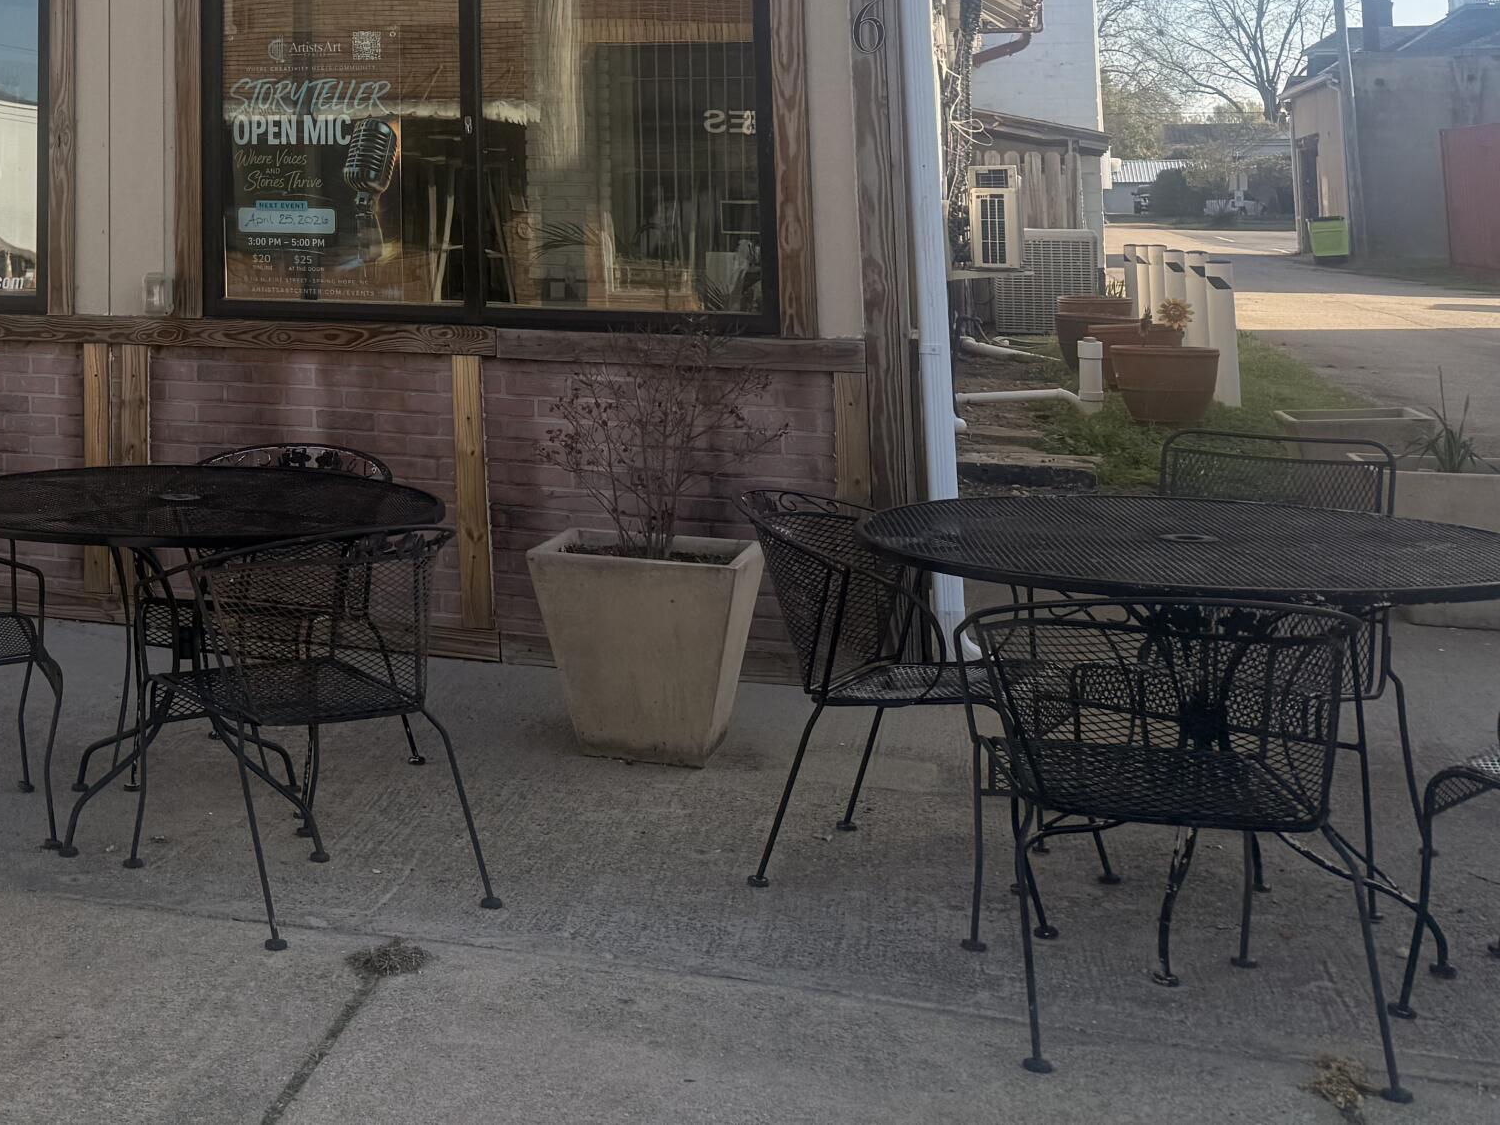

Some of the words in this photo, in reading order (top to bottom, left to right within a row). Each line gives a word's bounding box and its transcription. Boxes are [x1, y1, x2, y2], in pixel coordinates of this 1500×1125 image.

[288, 41, 324, 53] Artists
[324, 40, 342, 53] Art
[230, 77, 394, 115] STORYTELLER
[233, 114, 297, 145] OPEN
[303, 114, 351, 145] MIC
[235, 148, 273, 168] Where
[274, 148, 307, 167] Voices
[244, 169, 285, 191] Stories
[284, 170, 323, 191] Thrive
[258, 202, 279, 210] NEXT
[280, 202, 305, 210] EVENT
[248, 237, 267, 246] 3:00
[268, 237, 282, 246] PM
[291, 238, 310, 247] 5:00
[312, 238, 325, 247] PM
[252, 254, 271, 263] $20
[293, 255, 312, 264] $25
